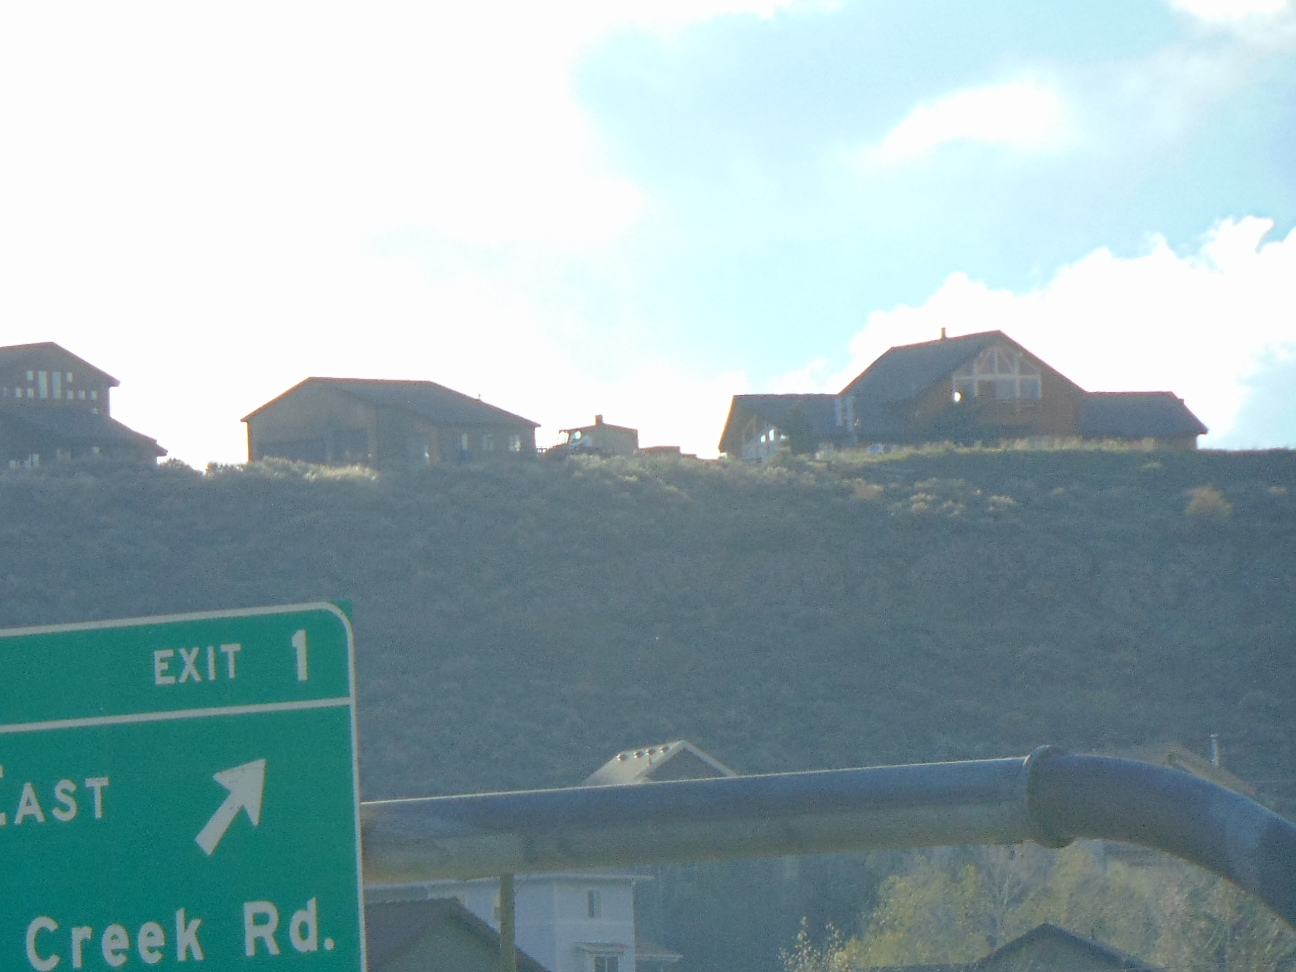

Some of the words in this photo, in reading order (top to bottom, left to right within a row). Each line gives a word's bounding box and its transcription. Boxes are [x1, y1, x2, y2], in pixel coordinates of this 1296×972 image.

[154, 643, 242, 685] EXIT
[291, 629, 309, 681] 1
[26, 908, 204, 972] Creek
[244, 898, 336, 957] Rd.
